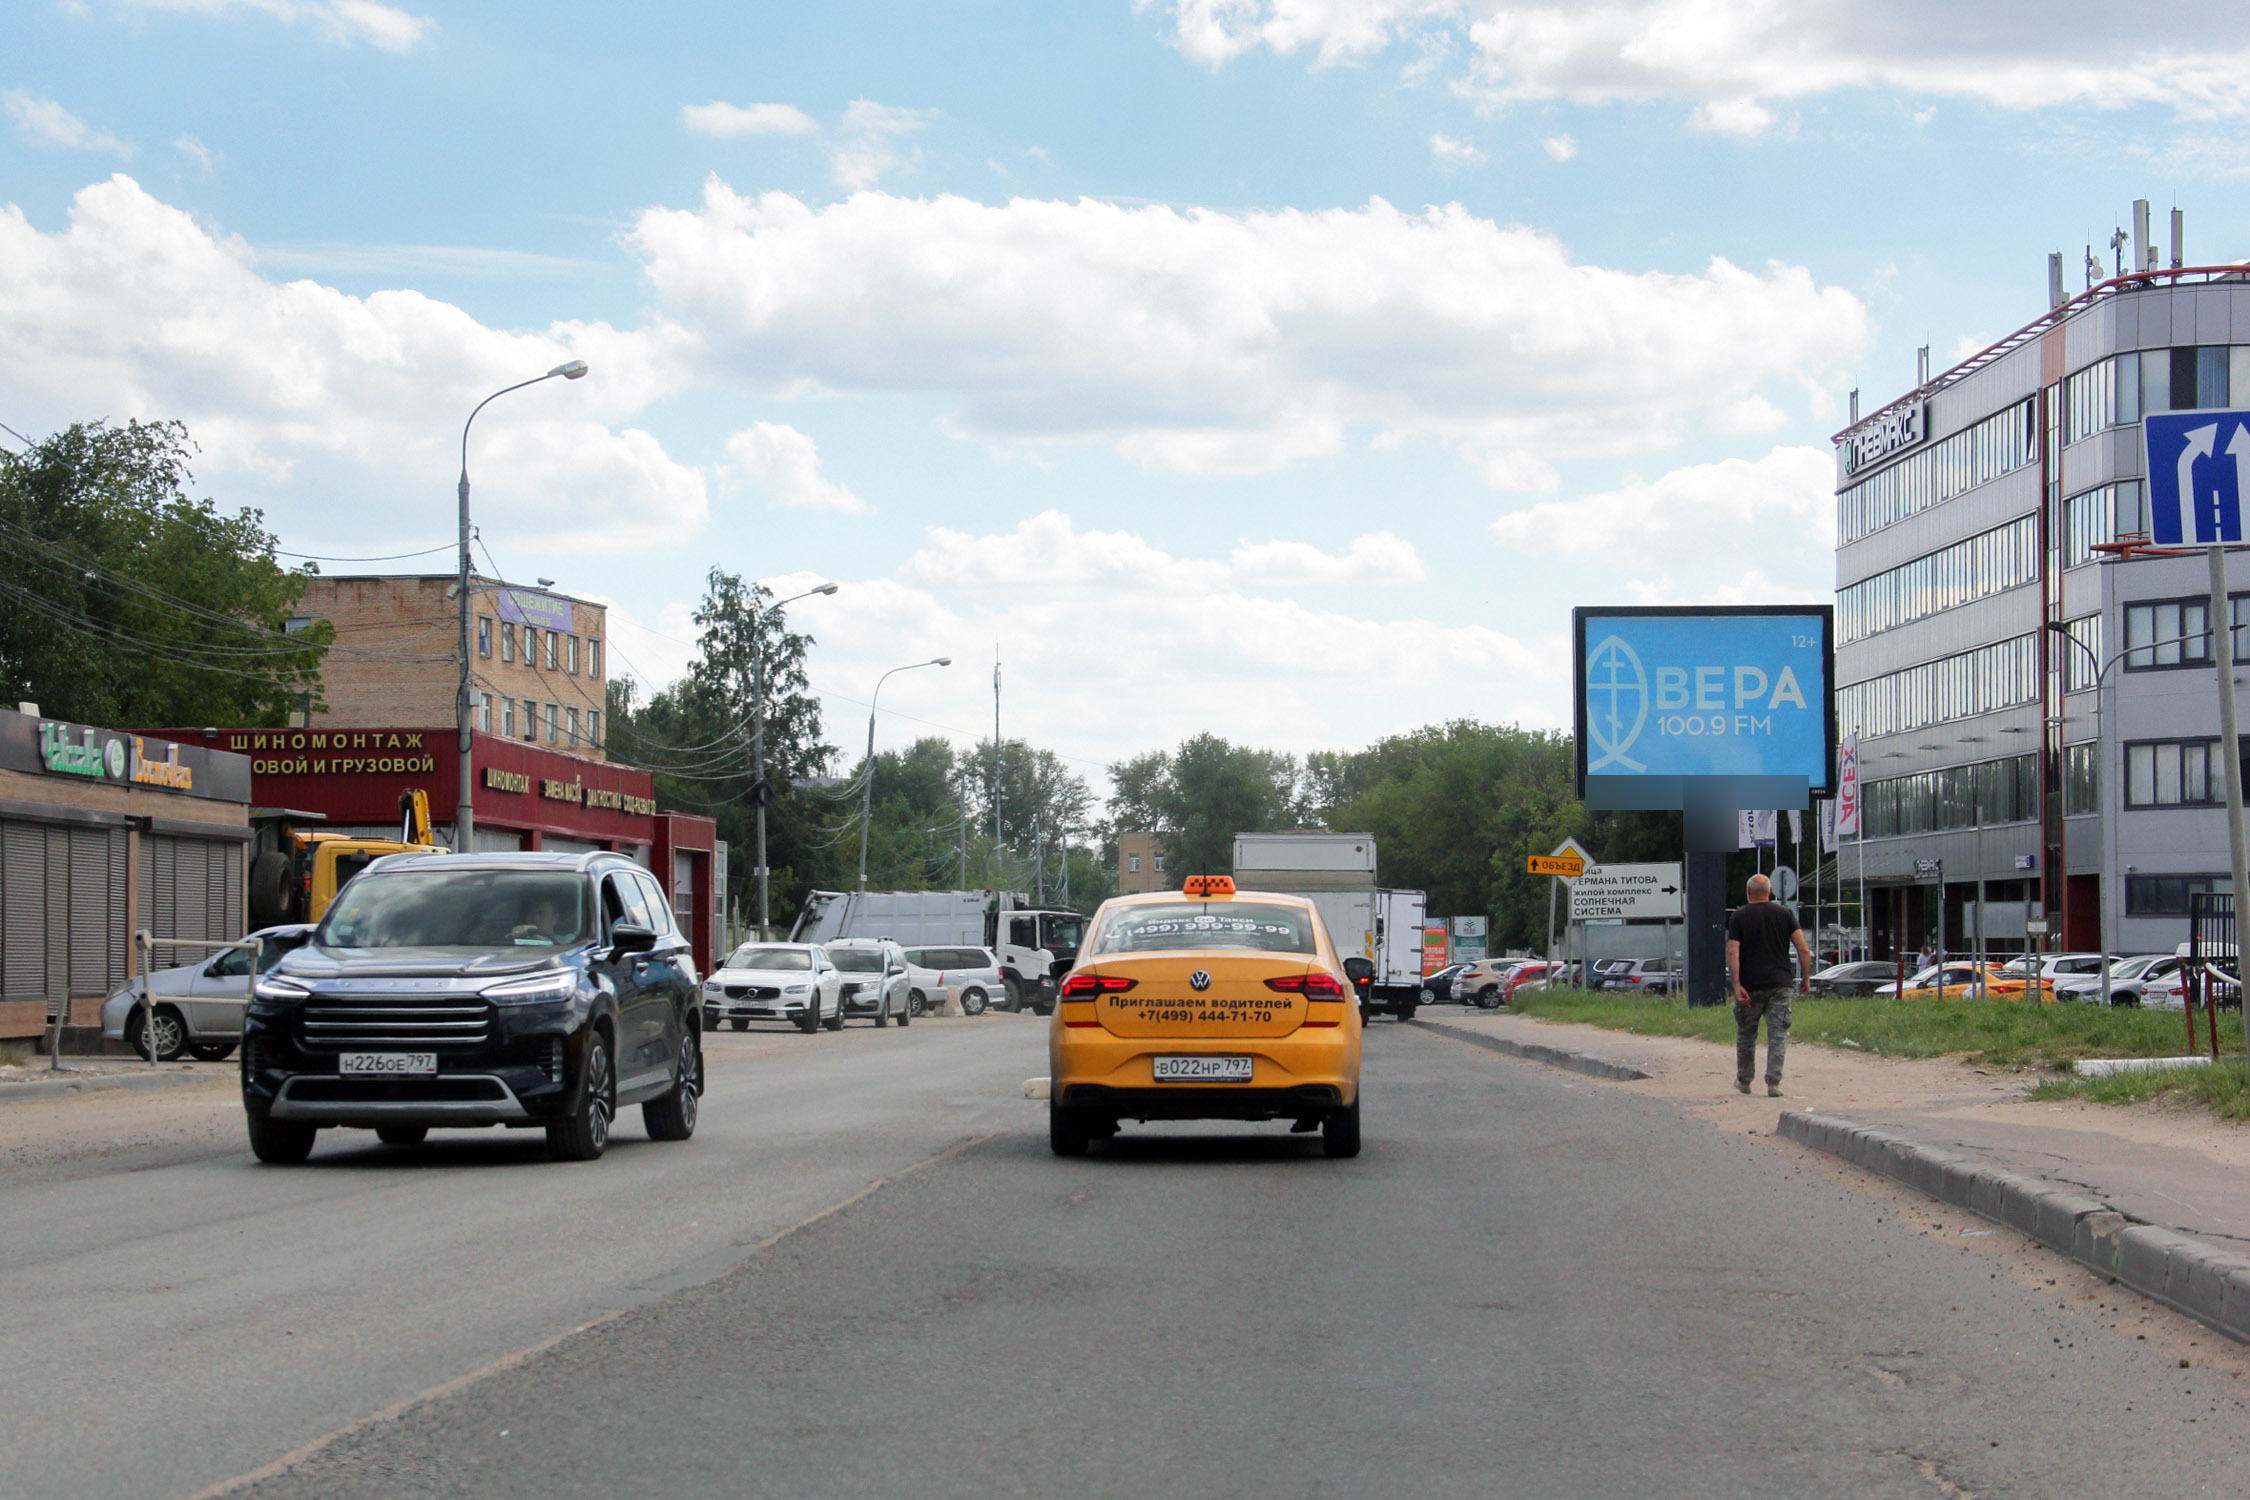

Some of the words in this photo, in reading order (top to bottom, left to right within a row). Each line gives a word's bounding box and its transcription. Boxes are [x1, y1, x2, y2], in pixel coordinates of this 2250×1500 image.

[1791, 635, 1817, 648] 12+
[1656, 665, 1808, 710] ВЕРА
[1657, 715, 1727, 736] 100.9
[1734, 715, 1771, 735] FM
[231, 733, 423, 750] ШИНОМОНТАЖ
[253, 755, 307, 774] ОВОЙ
[314, 760, 325, 773] И
[332, 754, 434, 773] ГРУЗОВОЙ
[486, 767, 530, 794] ШИНОМОНТАЖ
[1541, 861, 1581, 872] ОБЪЕЗД
[1621, 875, 1658, 885] ТИТОВА
[1574, 887, 1605, 897] жилой
[1607, 887, 1652, 896] комплекс
[1574, 896, 1636, 906] СОЛНЕЧНАЯ
[1574, 907, 1622, 916] СИСТЕМА
[1147, 917, 1192, 925] Яндекс
[1127, 924, 1178, 937] (499)
[1184, 922, 1291, 935] 999-99-99
[1109, 996, 1206, 1009] Приглашаем
[1211, 998, 1292, 1009] водителей
[1138, 1010, 1193, 1023] +7(499)
[1198, 1011, 1272, 1022] 444-71-70
